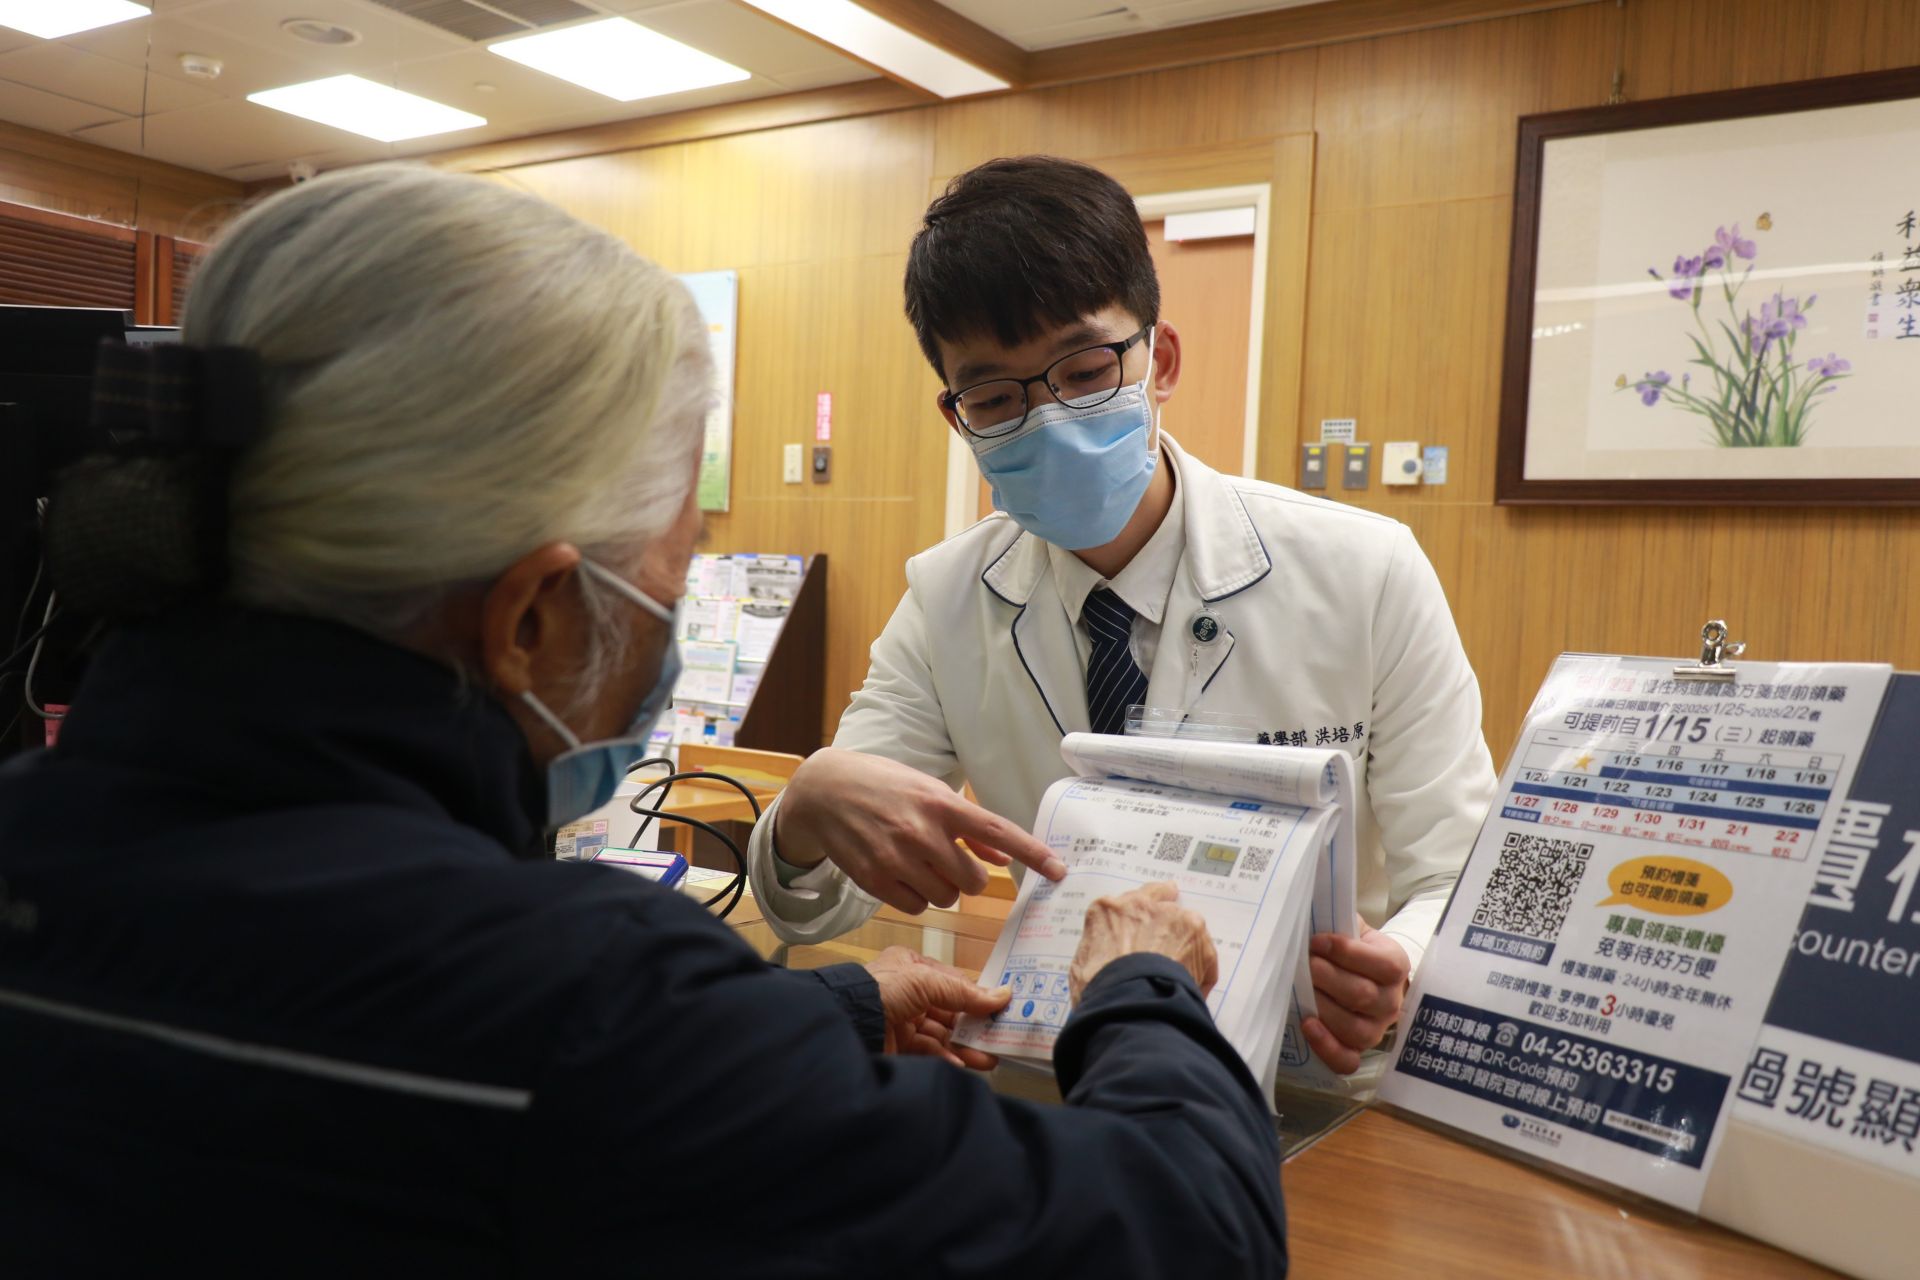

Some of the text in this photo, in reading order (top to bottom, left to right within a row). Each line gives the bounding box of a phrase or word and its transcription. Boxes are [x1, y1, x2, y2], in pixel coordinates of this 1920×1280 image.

[1315, 721, 1364, 746] 洪培原
[1614, 754, 1827, 785] 1/15 1/16 1/17 1/18 1/19
[1669, 745, 1681, 757] 四
[1712, 748, 1726, 761] 五
[1759, 753, 1773, 765] 六
[1808, 756, 1822, 769] 日
[1525, 771, 1816, 814] 1/20 1/21 1/22 1/23 1/24 1/25 1/26
[1514, 796, 1800, 843] 1/27 1/28 1/29 1/30 1/31 2/1 2/2
[1620, 880, 1709, 908] 也可提前領藥
[1469, 931, 1546, 961] 掃碼立刻預約
[1595, 936, 1717, 980] 免等待好方便
[1792, 927, 1920, 978] ounter
[1528, 1001, 1612, 1035] 歡迎多加利用
[1408, 1027, 1580, 1092] (2)手機掃碼QR-Code預約
[1416, 1006, 1677, 1093] (1)預約專線 04-25363315
[1401, 1046, 1602, 1125] (3)台中慈濟醫院官網線上預約
